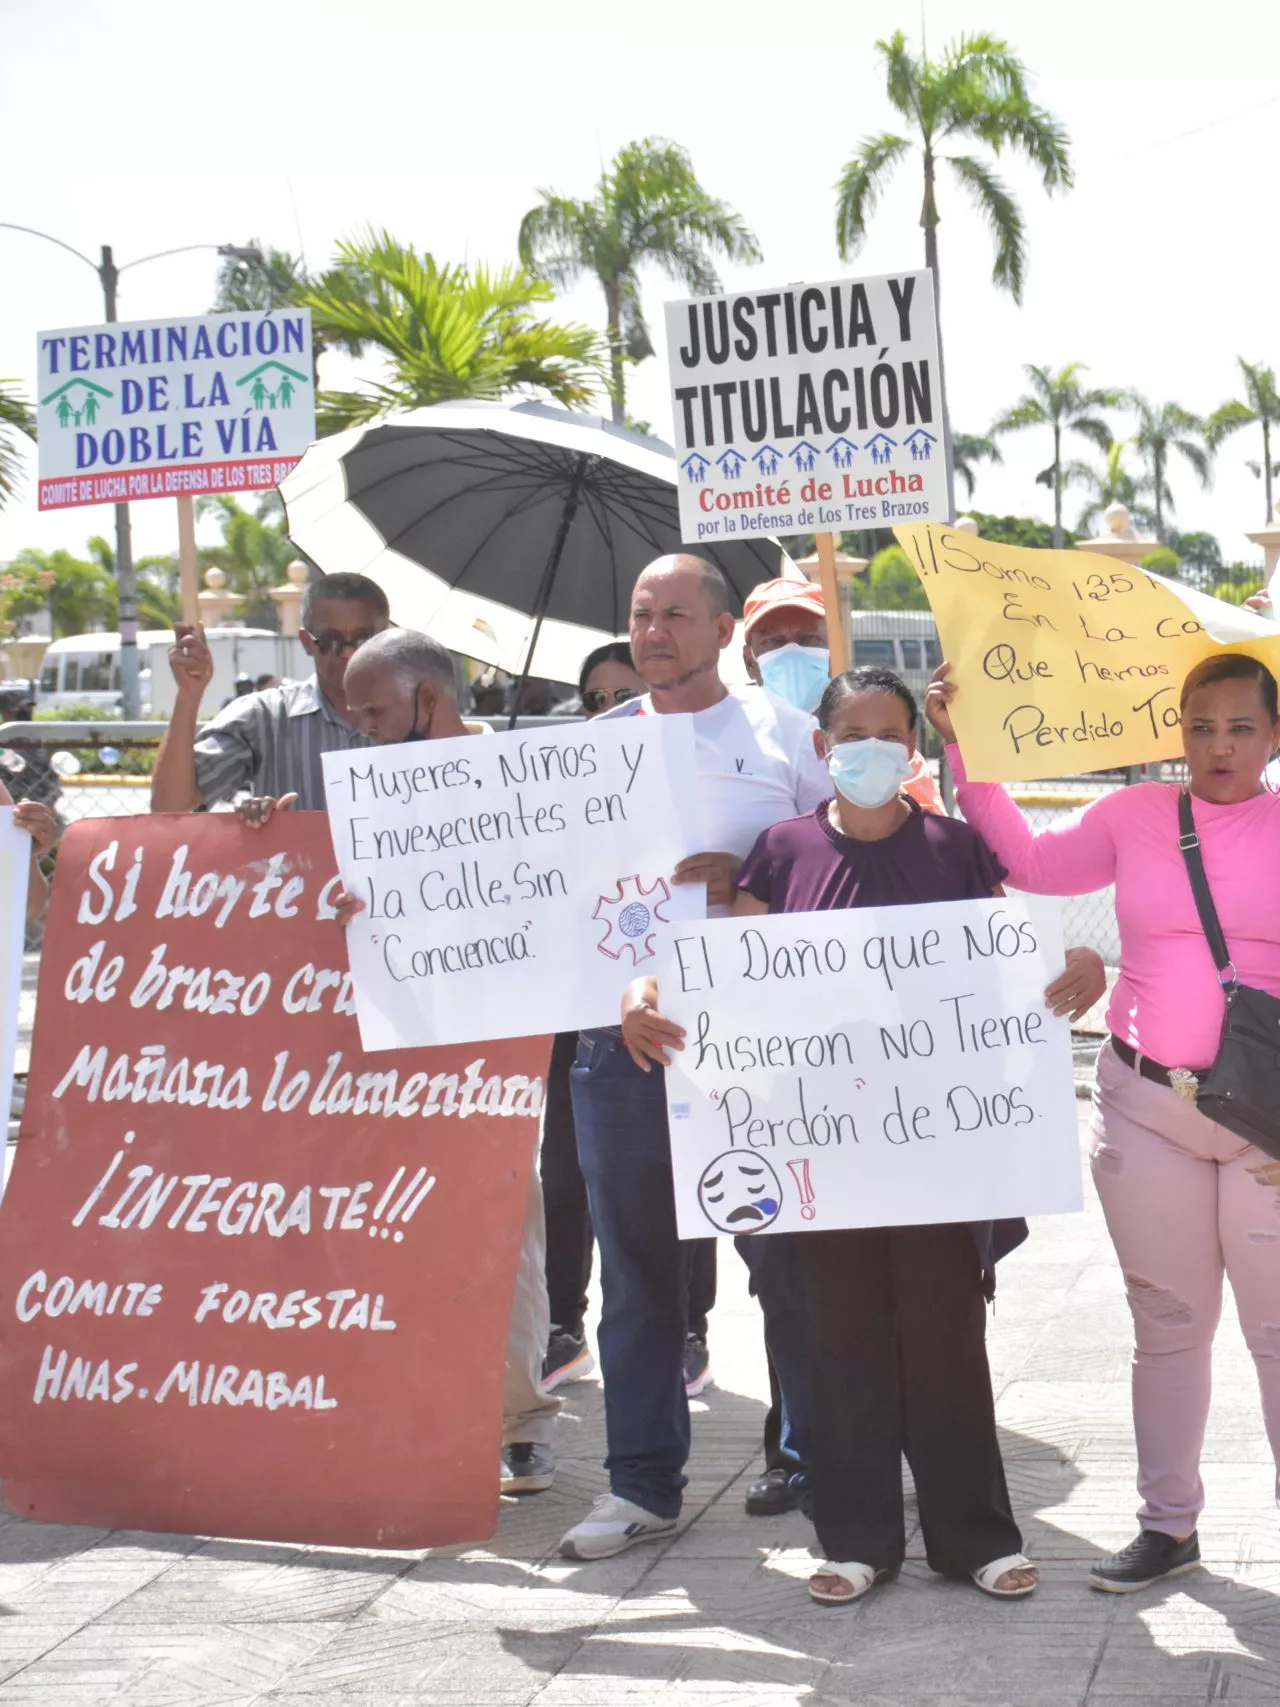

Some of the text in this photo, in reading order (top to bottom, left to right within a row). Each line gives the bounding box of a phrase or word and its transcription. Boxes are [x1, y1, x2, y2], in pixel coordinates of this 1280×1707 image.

[42, 310, 304, 374] TERMINACIÓN
[680, 277, 916, 368] JUSTICIA Y
[121, 372, 231, 415] DE LA
[675, 347, 933, 448] TITULACIÓN
[76, 408, 278, 469] DOBLE VÍA
[41, 477, 78, 505] COMITÉ
[80, 480, 93, 500] DE
[94, 476, 127, 499] LUCHA
[129, 473, 150, 496] POR
[151, 473, 165, 493] LA
[165, 468, 209, 492] DEFENSA
[211, 467, 224, 488] DE
[226, 466, 245, 487] LOS
[246, 464, 271, 485] TRES
[699, 470, 924, 512] Comité de Lucha
[697, 500, 929, 539] por la Defensa de Los Tres Brazos
[1003, 592, 1058, 632] En
[1079, 615, 1138, 642] La
[983, 643, 1170, 684] Que hemos
[1002, 705, 1124, 755] Perdido
[500, 742, 597, 788] Niños
[585, 793, 627, 825] en
[77, 840, 144, 925] Si
[368, 876, 406, 919] La
[513, 861, 568, 899] Sin
[64, 940, 125, 1004] de
[130, 943, 272, 1016] brazo
[674, 910, 1038, 993] El Daño que Nos
[693, 1011, 854, 1073] hisieron
[940, 993, 1047, 1054] Tiene
[52, 1044, 252, 1109] Mañana
[261, 1050, 310, 1113] lo
[883, 1085, 936, 1145] de
[15, 1269, 398, 1332] COMITE FORESTAL
[33, 1344, 338, 1411] HNAS. MIRABAL
